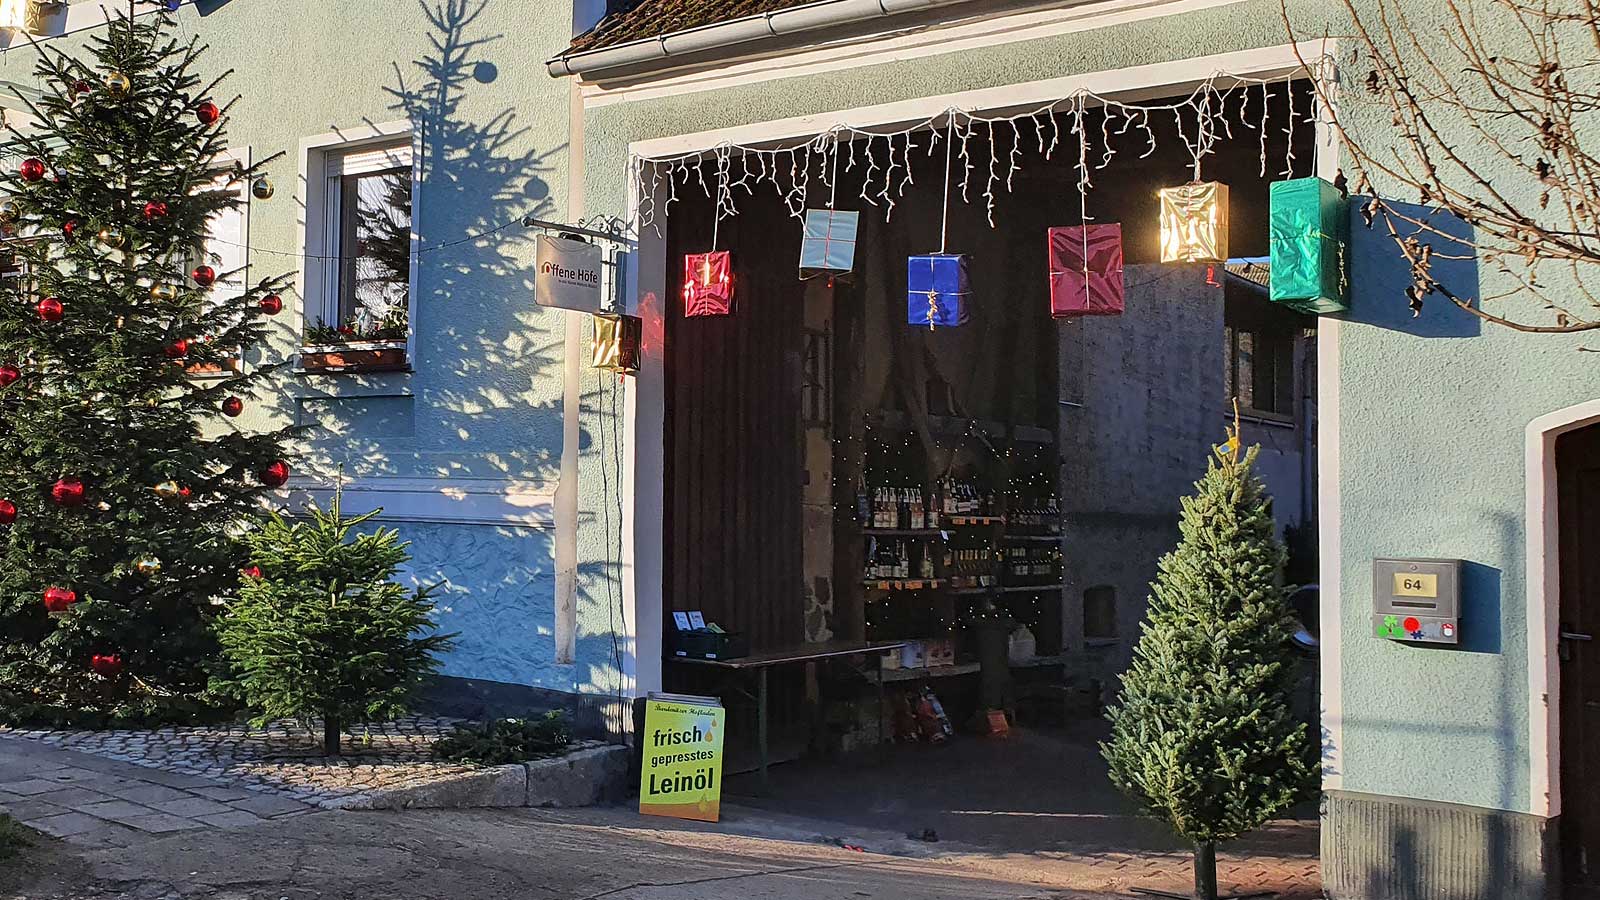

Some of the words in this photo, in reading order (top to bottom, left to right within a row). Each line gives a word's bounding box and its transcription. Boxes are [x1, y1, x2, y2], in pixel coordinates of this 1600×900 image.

[541, 262, 576, 280] Offene
[578, 268, 598, 284] Höfe
[1403, 579, 1421, 590] 64
[653, 726, 702, 746] frisch
[651, 750, 714, 768] gepresstes
[649, 767, 714, 795] Leinöl
